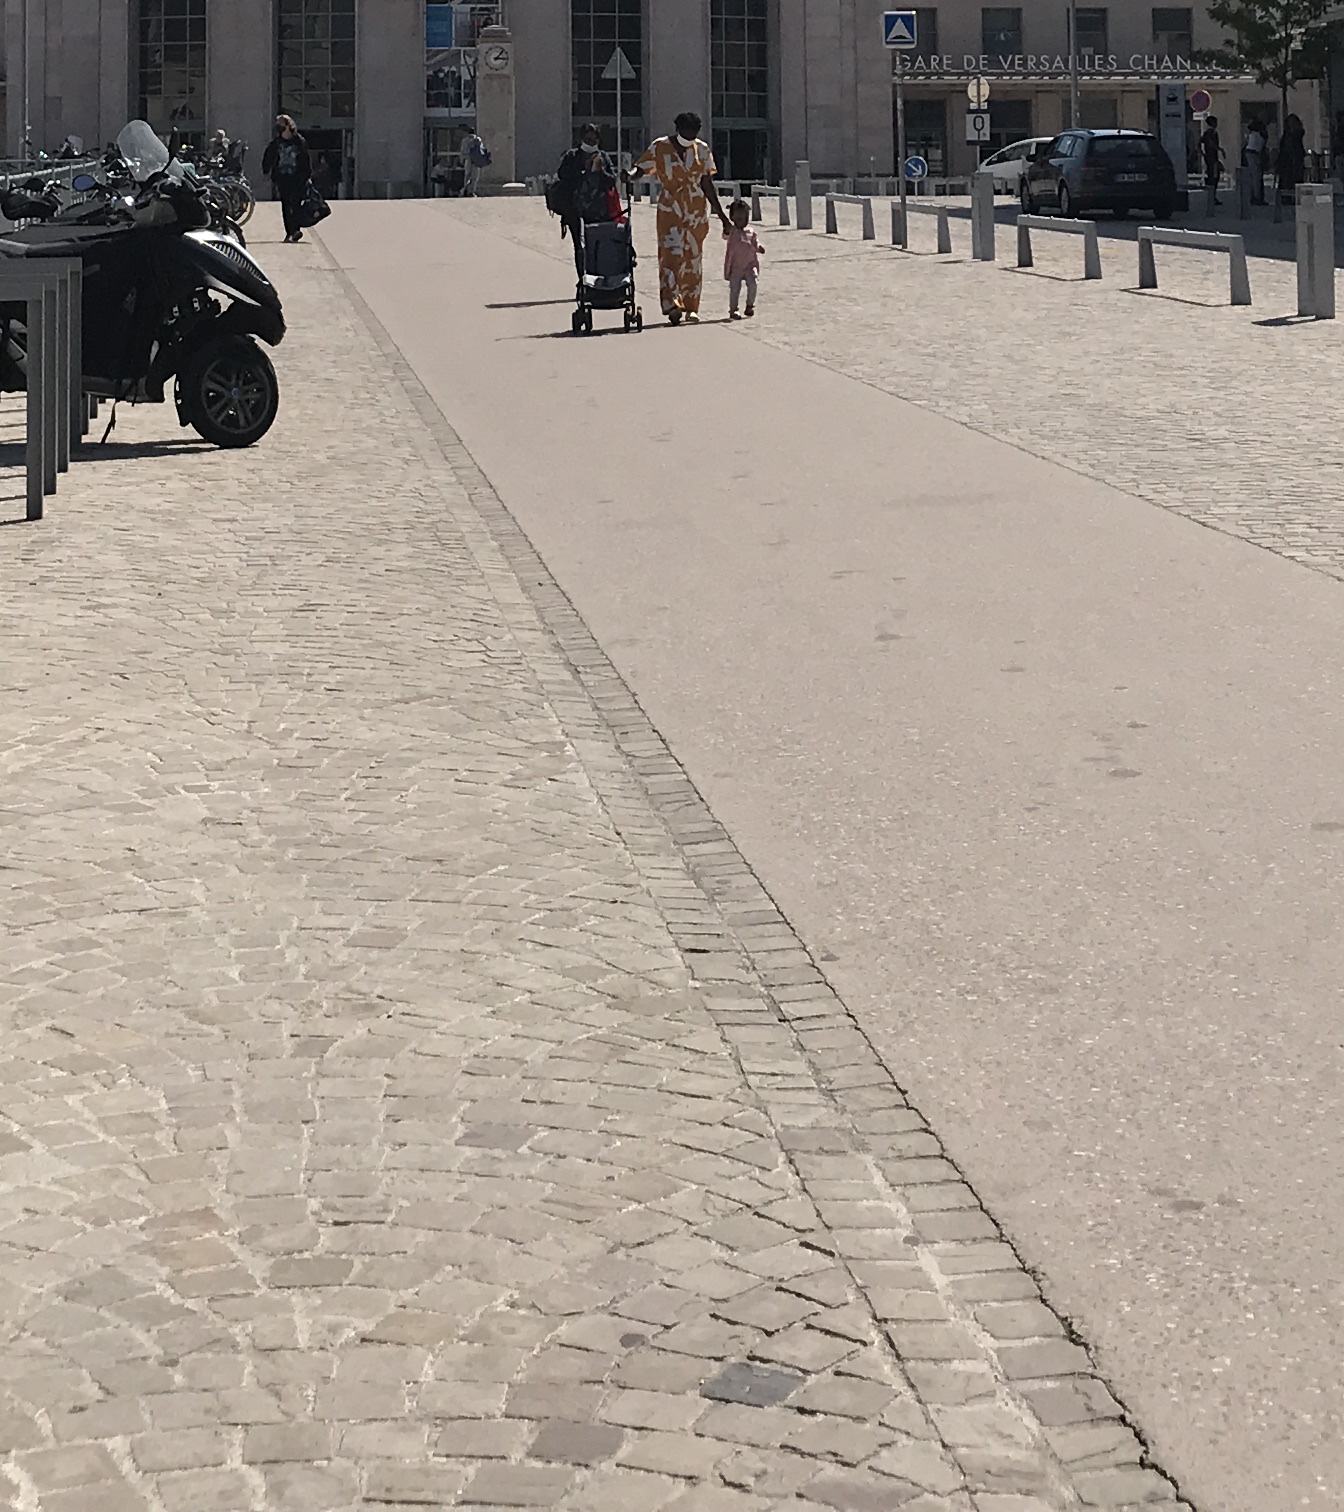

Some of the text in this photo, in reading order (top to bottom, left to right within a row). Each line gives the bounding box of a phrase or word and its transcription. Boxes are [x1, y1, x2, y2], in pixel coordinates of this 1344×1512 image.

[897, 54, 952, 70] GARE
[964, 54, 989, 70] DE
[998, 54, 1117, 70] VERSAILLES
